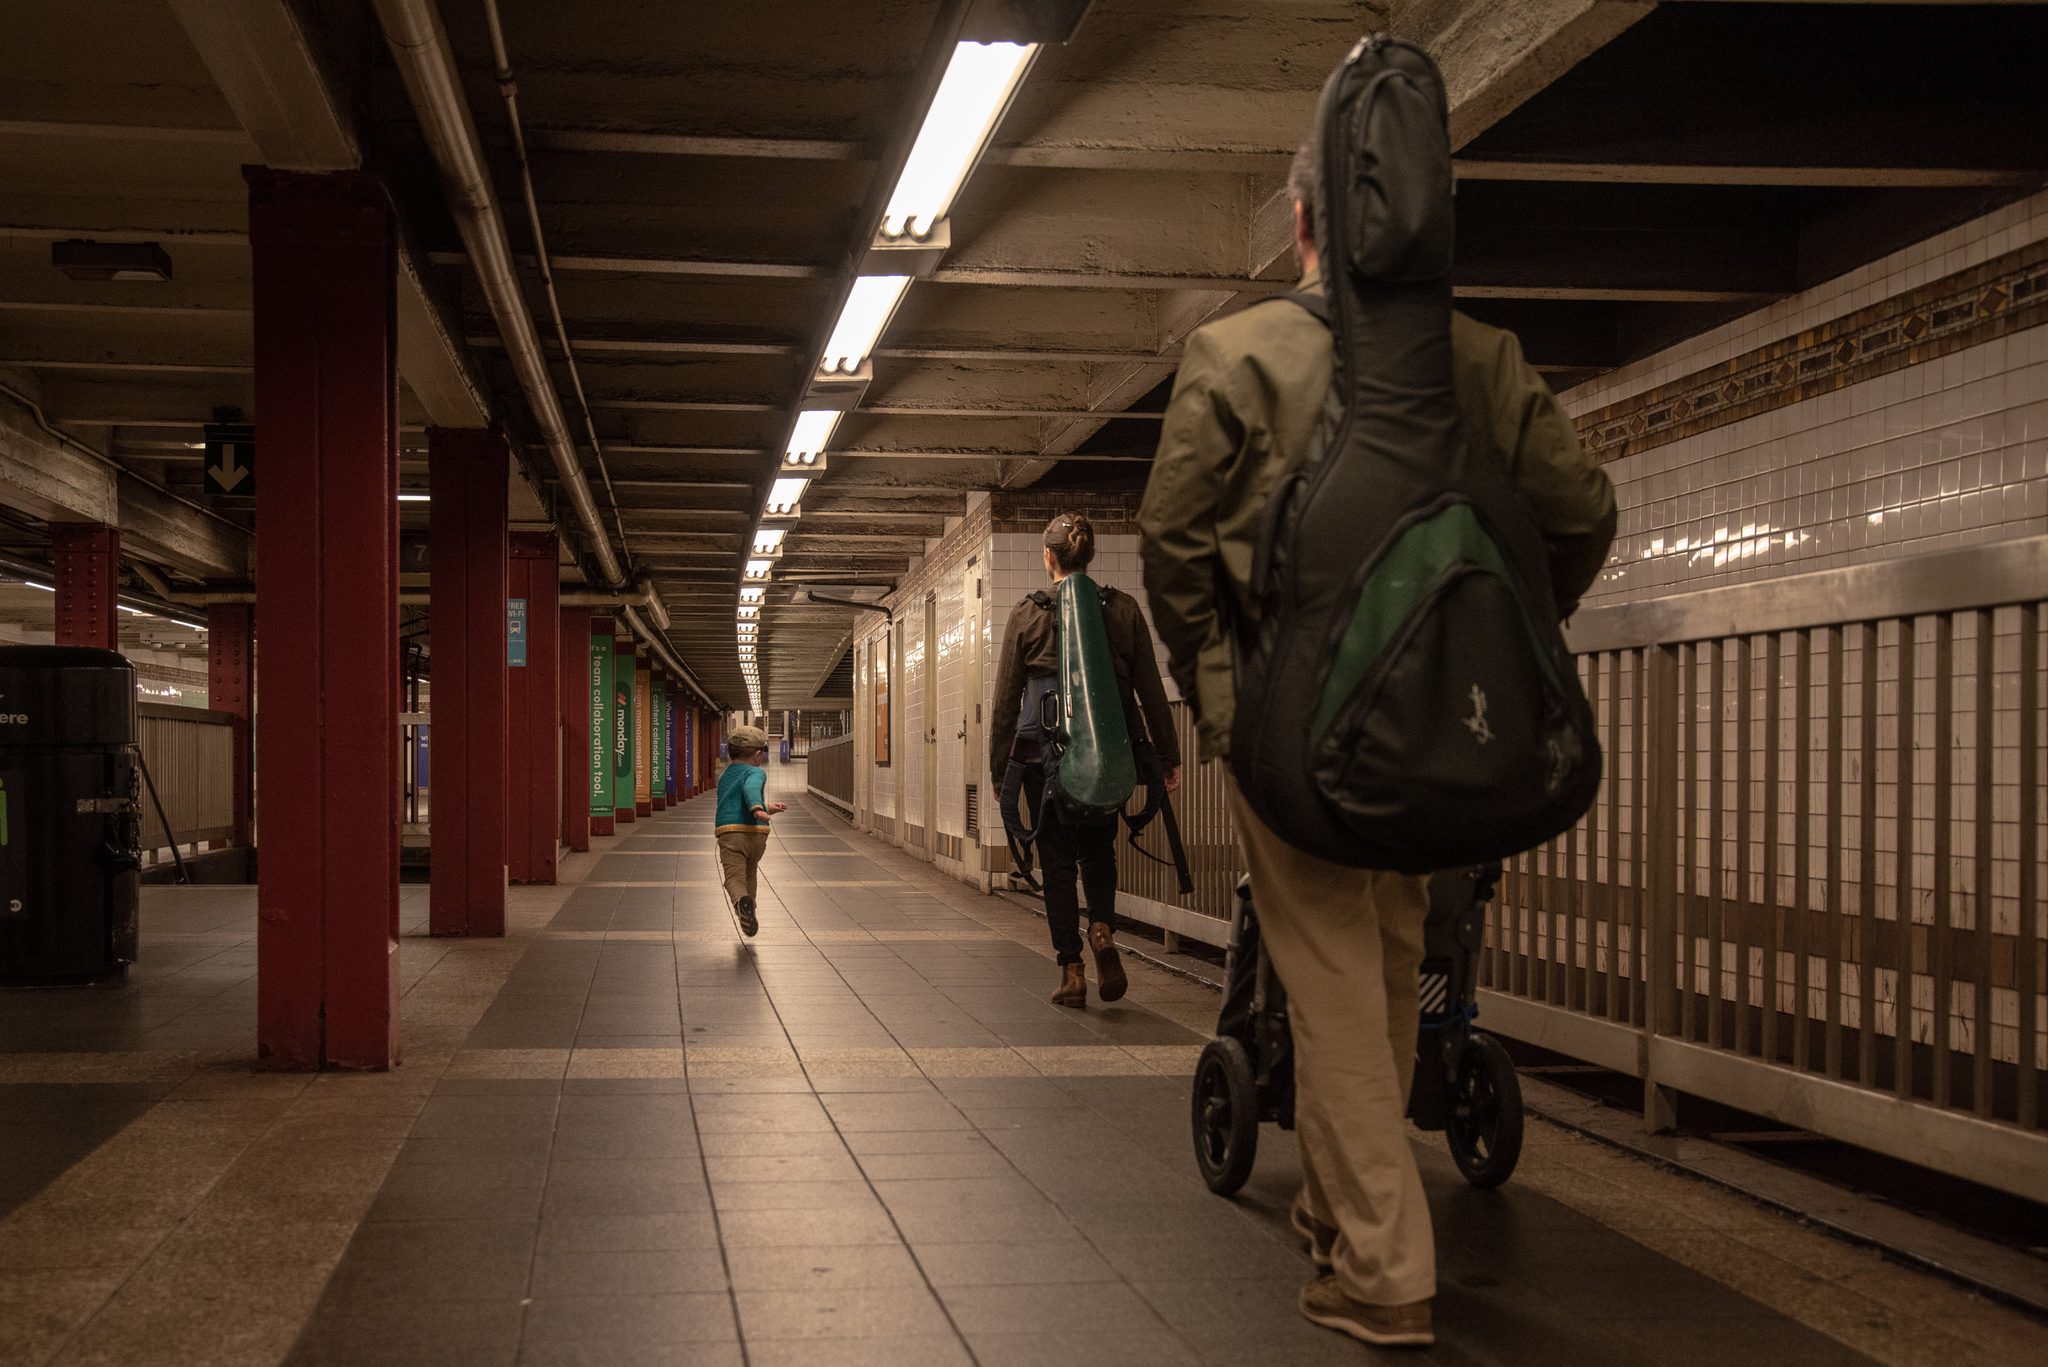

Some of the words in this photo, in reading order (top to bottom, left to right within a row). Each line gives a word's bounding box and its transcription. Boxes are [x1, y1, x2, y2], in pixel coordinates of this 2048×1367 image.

[414, 545, 427, 561] 7
[594, 656, 602, 685] team
[652, 694, 660, 726] content
[594, 689, 604, 768] collaboration
[652, 727, 661, 765] calendar
[594, 772, 604, 797] tool.
[652, 766, 661, 784] tool.
